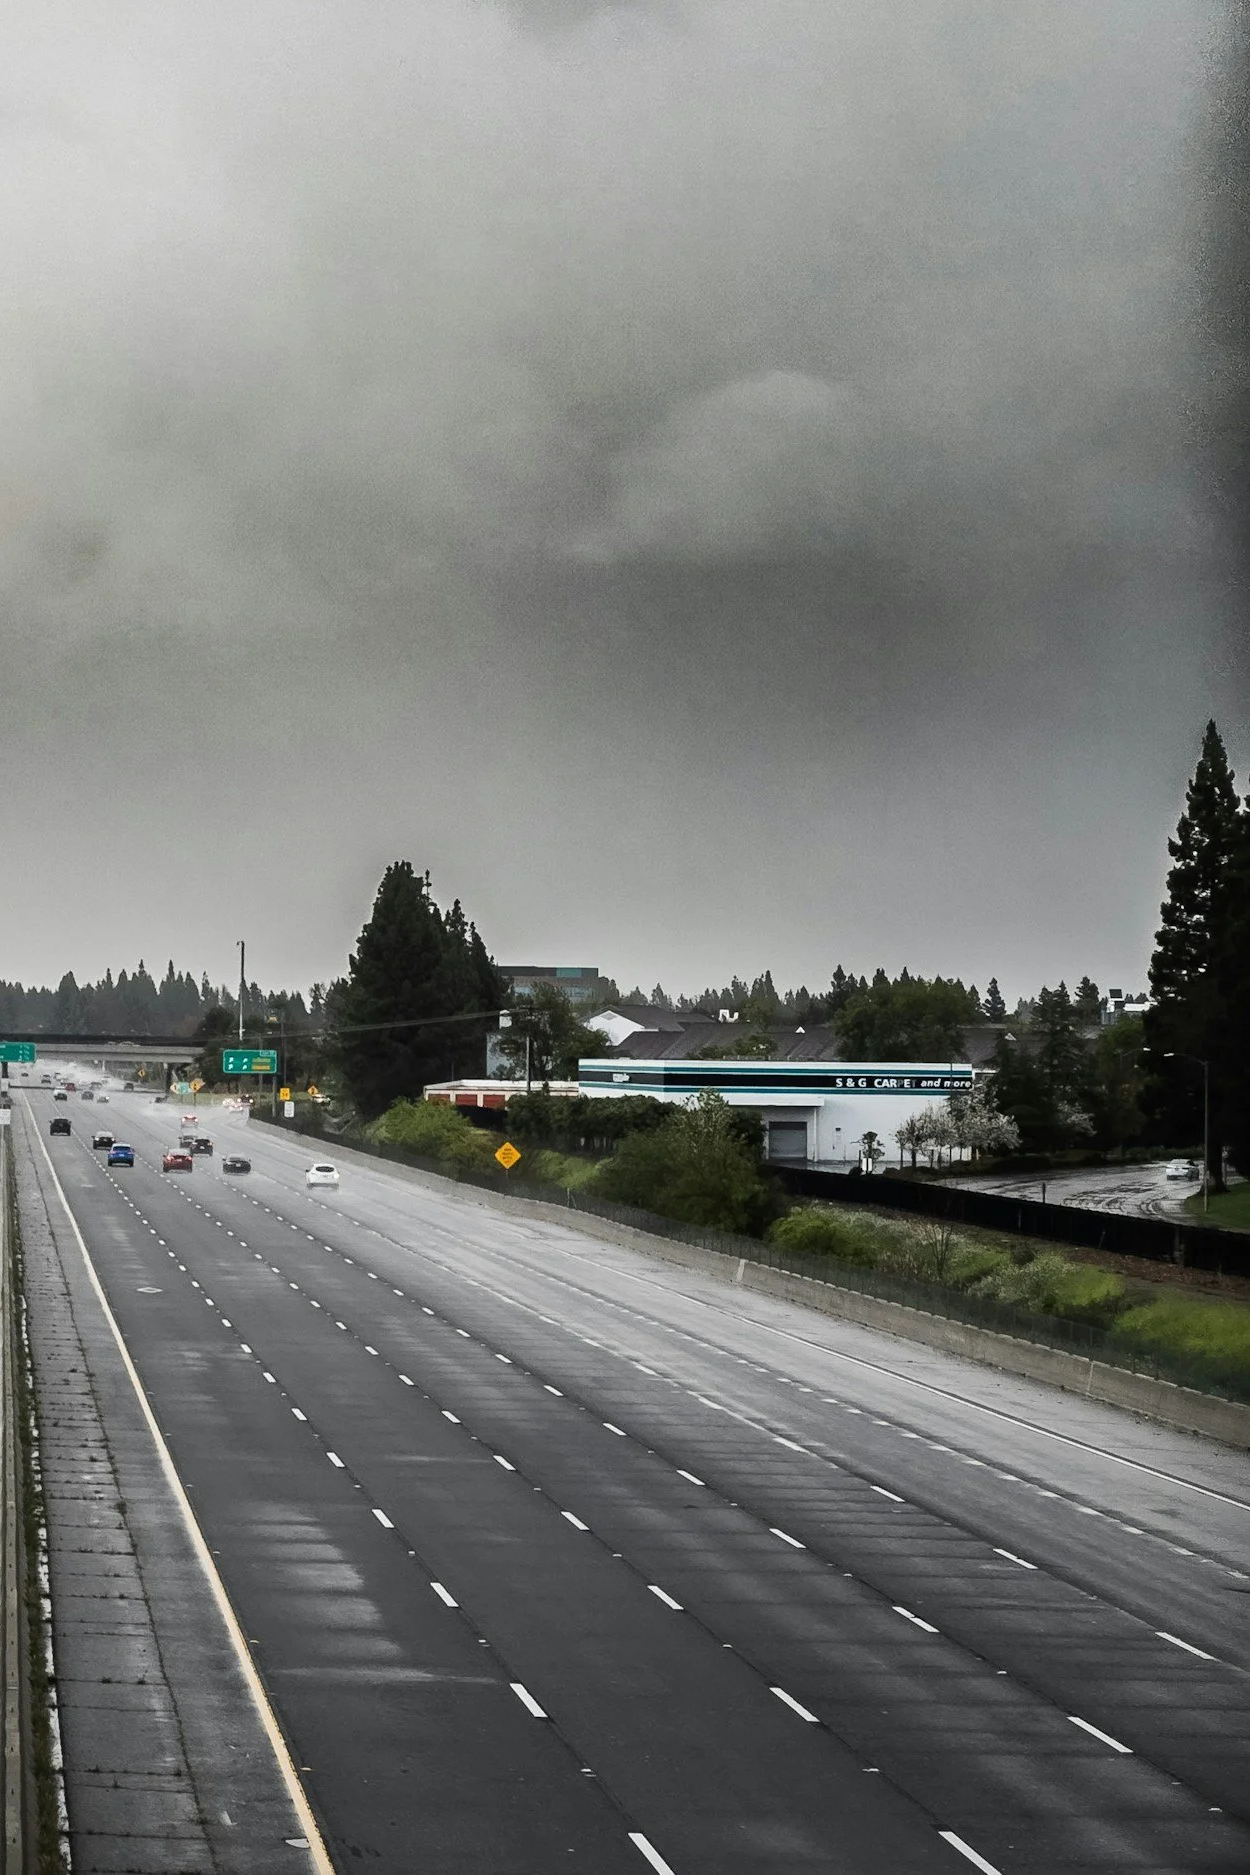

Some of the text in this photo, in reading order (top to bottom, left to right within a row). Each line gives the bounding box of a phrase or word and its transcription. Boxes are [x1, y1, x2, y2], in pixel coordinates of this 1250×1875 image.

[836, 1078, 843, 1087] S
[846, 1078, 855, 1087] &
[858, 1078, 867, 1087] G
[921, 1078, 941, 1087] and
[944, 1079, 971, 1088] more
